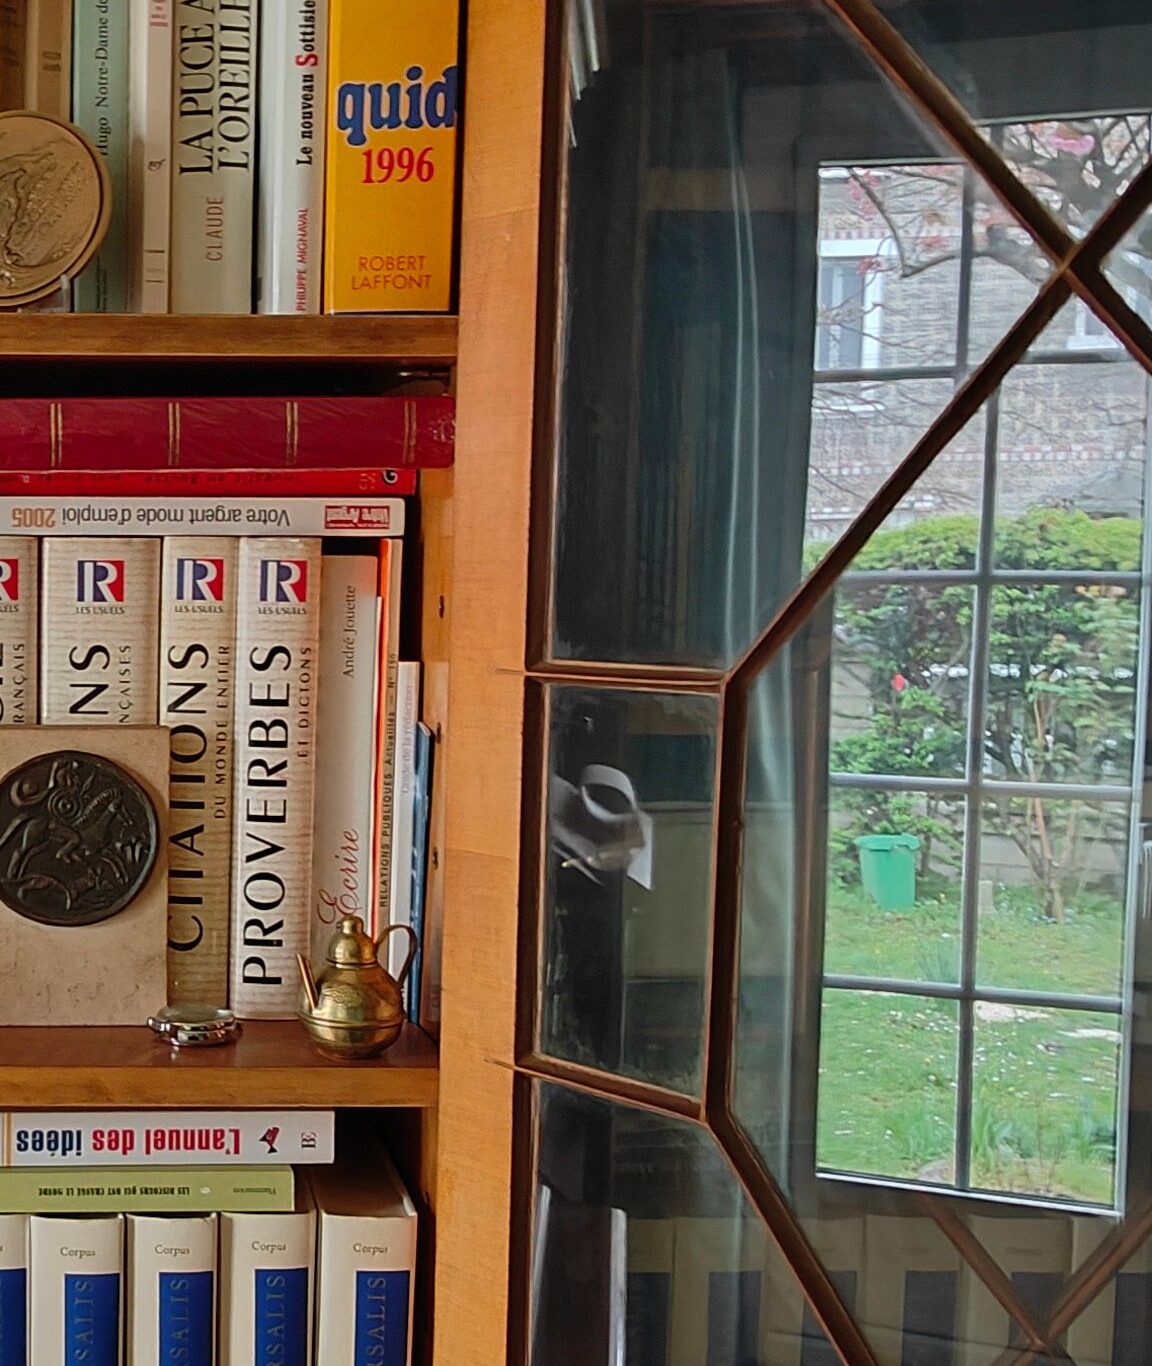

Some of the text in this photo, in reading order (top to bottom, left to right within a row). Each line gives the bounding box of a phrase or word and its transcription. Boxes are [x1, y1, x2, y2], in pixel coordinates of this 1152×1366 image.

[94, 19, 108, 108] Notre-Dame
[179, 22, 215, 118] PUCE
[300, 73, 315, 140] nouveau
[336, 64, 459, 147] quid
[179, 127, 215, 176] LA
[297, 146, 314, 166] Le
[361, 146, 436, 185] 1996
[205, 195, 224, 262] CLAUDE
[358, 255, 427, 272] ROBERT
[351, 274, 433, 291] LAFFONT
[11, 504, 291, 528] Votre argent mode d'emploi 2005
[341, 585, 357, 679] André Jouette
[297, 646, 312, 758] ET DICTONS
[214, 645, 231, 820] DU MONDE ENTIER
[166, 643, 209, 952] CITATIONS
[379, 710, 396, 908] RELATIONS PUBLIQUES Actualités
[242, 645, 292, 985] PROVERBES
[15, 1129, 83, 1157] idées
[91, 1128, 135, 1155] des
[145, 1128, 241, 1155] L'annuel
[177, 1186, 190, 1196] LES
[232, 1187, 277, 1196] Flammarion
[59, 1246, 96, 1258] Corpus
[154, 1244, 191, 1256] Corpus
[251, 1240, 287, 1253] Corpus
[352, 1242, 389, 1255] Corpus
